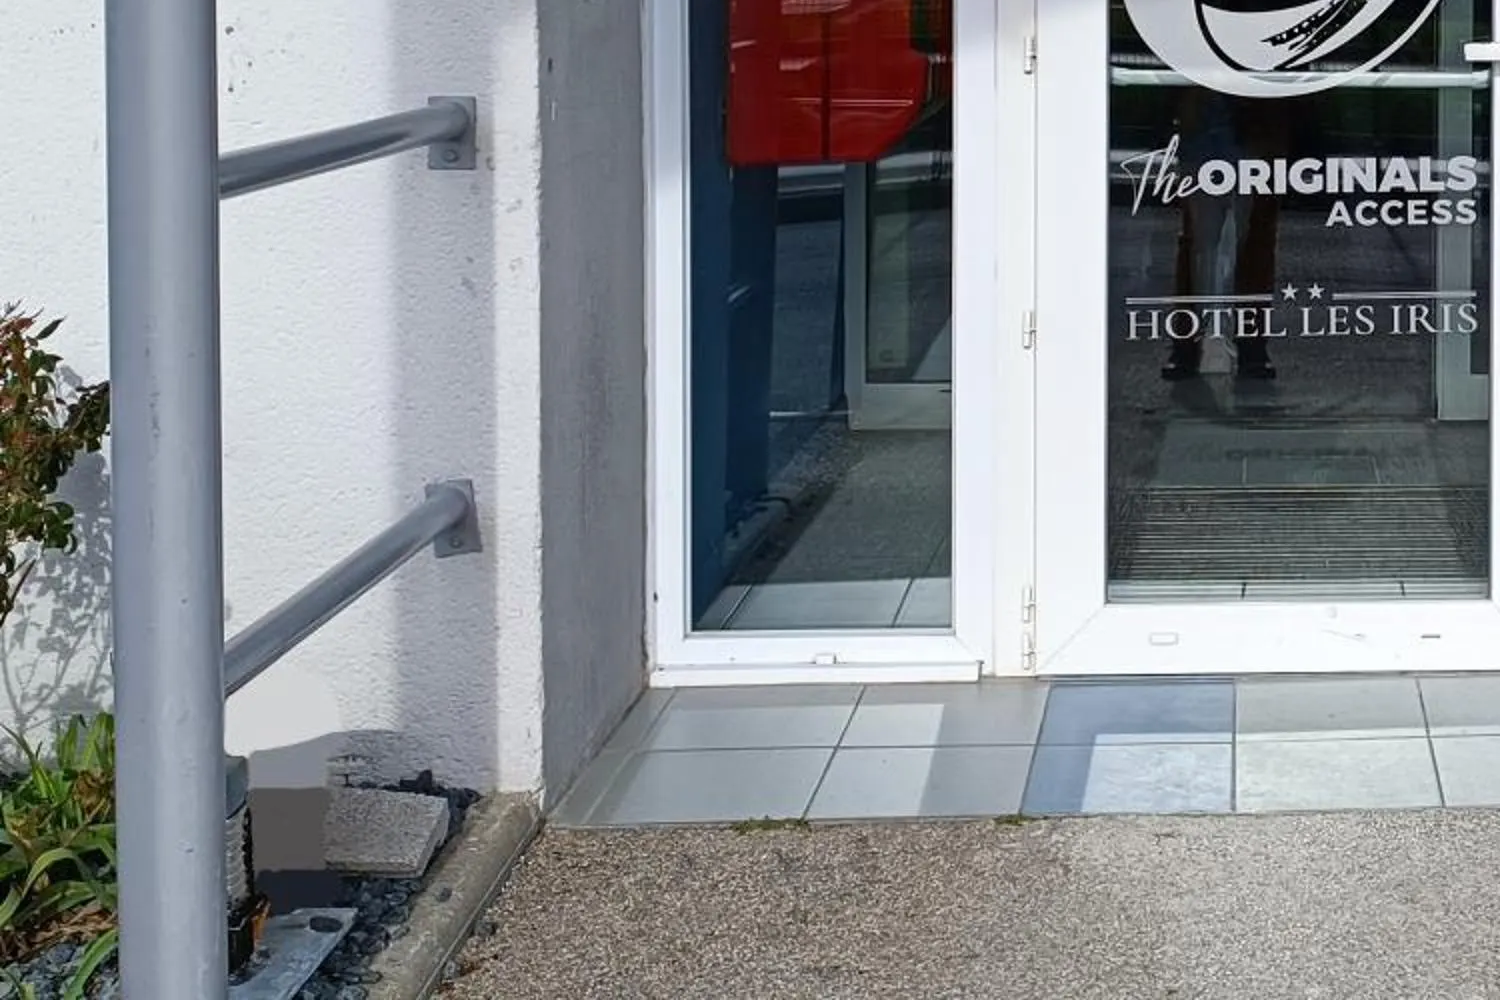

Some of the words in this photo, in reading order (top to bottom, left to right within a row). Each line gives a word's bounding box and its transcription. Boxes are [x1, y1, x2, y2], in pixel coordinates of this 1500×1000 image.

[1119, 133, 1202, 217] The
[1197, 155, 1478, 195] ORIGINALS
[1325, 199, 1478, 227] ACCESS
[1125, 306, 1288, 341] HOTEL
[1300, 303, 1376, 338] LES
[1391, 302, 1479, 336] IRIS
